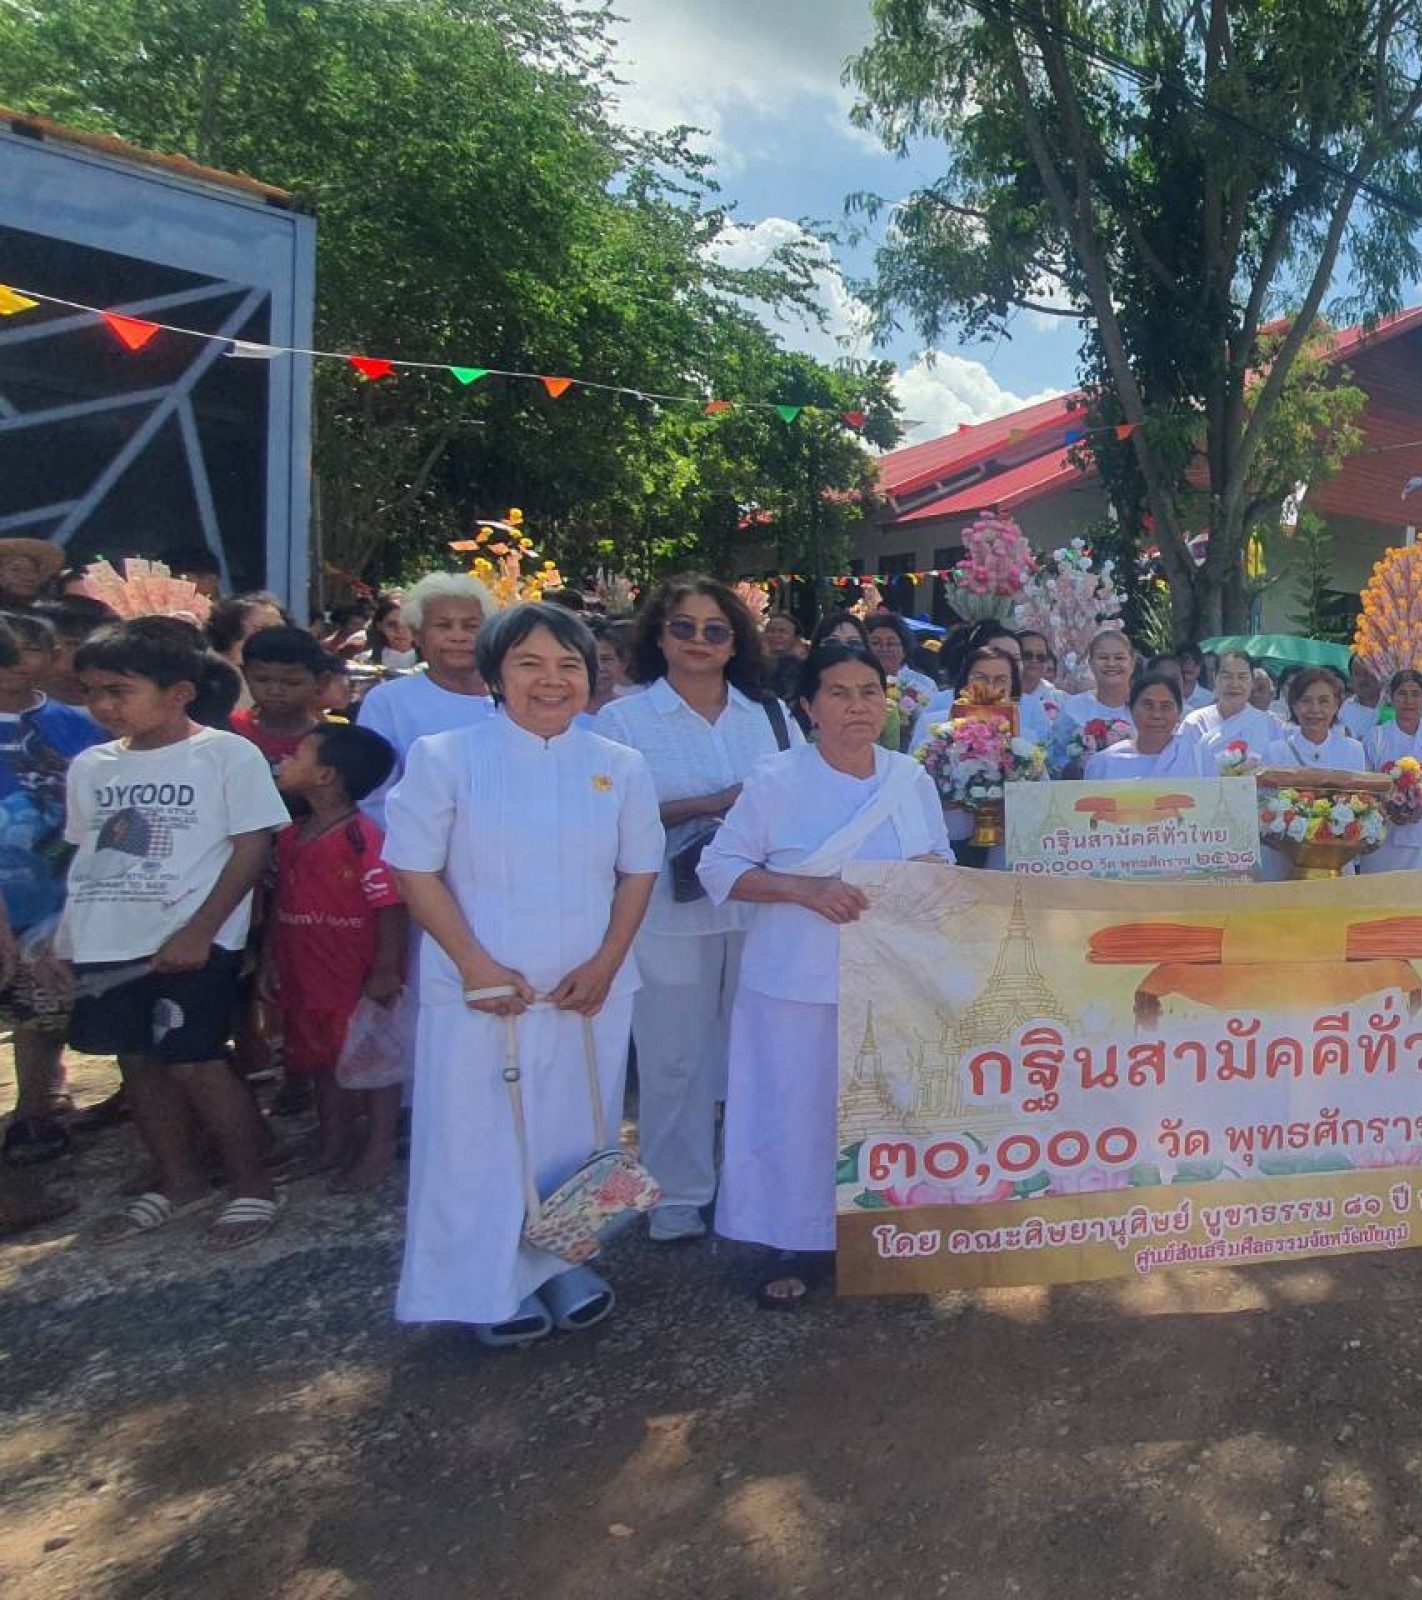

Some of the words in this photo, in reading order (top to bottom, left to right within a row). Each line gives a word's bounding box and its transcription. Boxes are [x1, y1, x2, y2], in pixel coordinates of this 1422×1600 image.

[1042, 821, 1228, 856] กฐินสามัคคีทั่วไทย
[1196, 850, 1254, 866] ๒๕๖๘
[869, 1126, 1138, 1186] ๓๐,๐๐๐
[1157, 1117, 1210, 1159] วัด
[877, 1227, 937, 1254] โดย
[952, 1201, 1190, 1251] คณะศิษยานุศิษย์
[1203, 1199, 1331, 1237] บูชาธรรม
[1344, 1196, 1381, 1216] ๘๑
[1392, 1186, 1410, 1211] ปี
